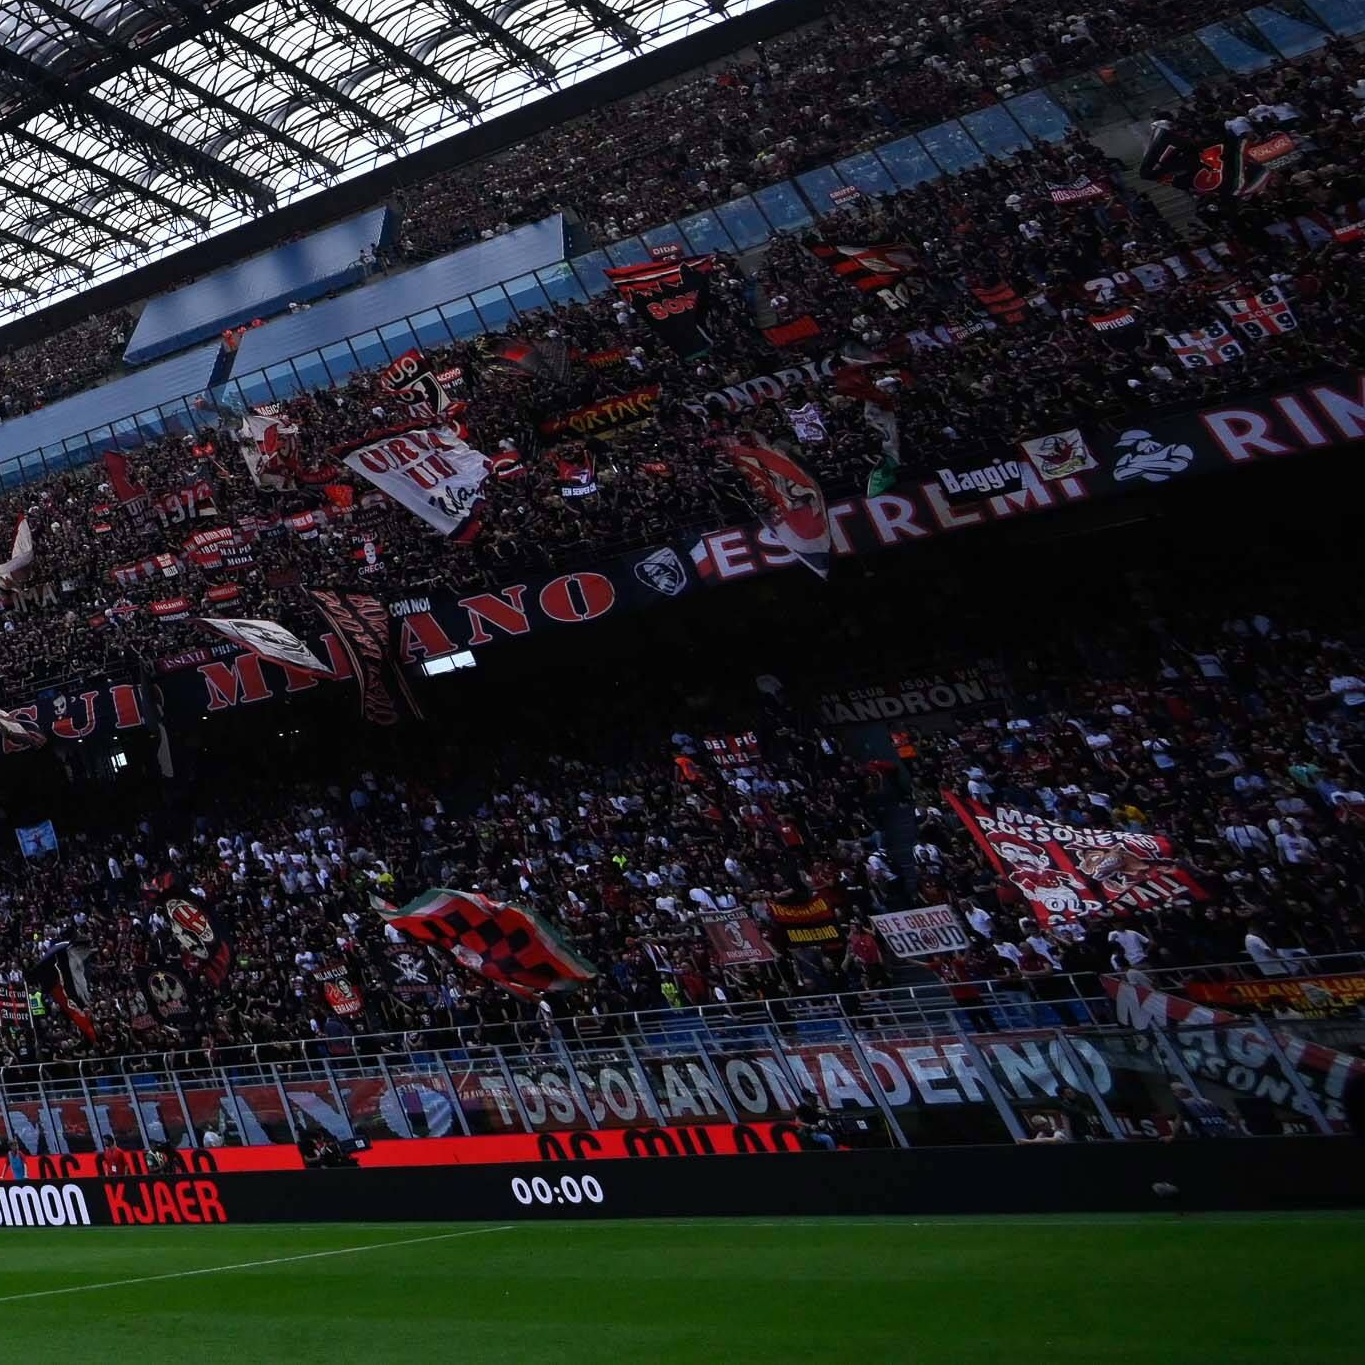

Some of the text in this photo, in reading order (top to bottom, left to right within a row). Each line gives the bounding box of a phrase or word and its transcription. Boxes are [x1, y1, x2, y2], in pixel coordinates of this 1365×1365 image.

[938, 459, 1021, 495] Baggio
[878, 921, 890, 933] SI
[906, 910, 953, 929] GIRATO
[103, 1179, 228, 1225] KJAER
[511, 1175, 604, 1206] 00:00
